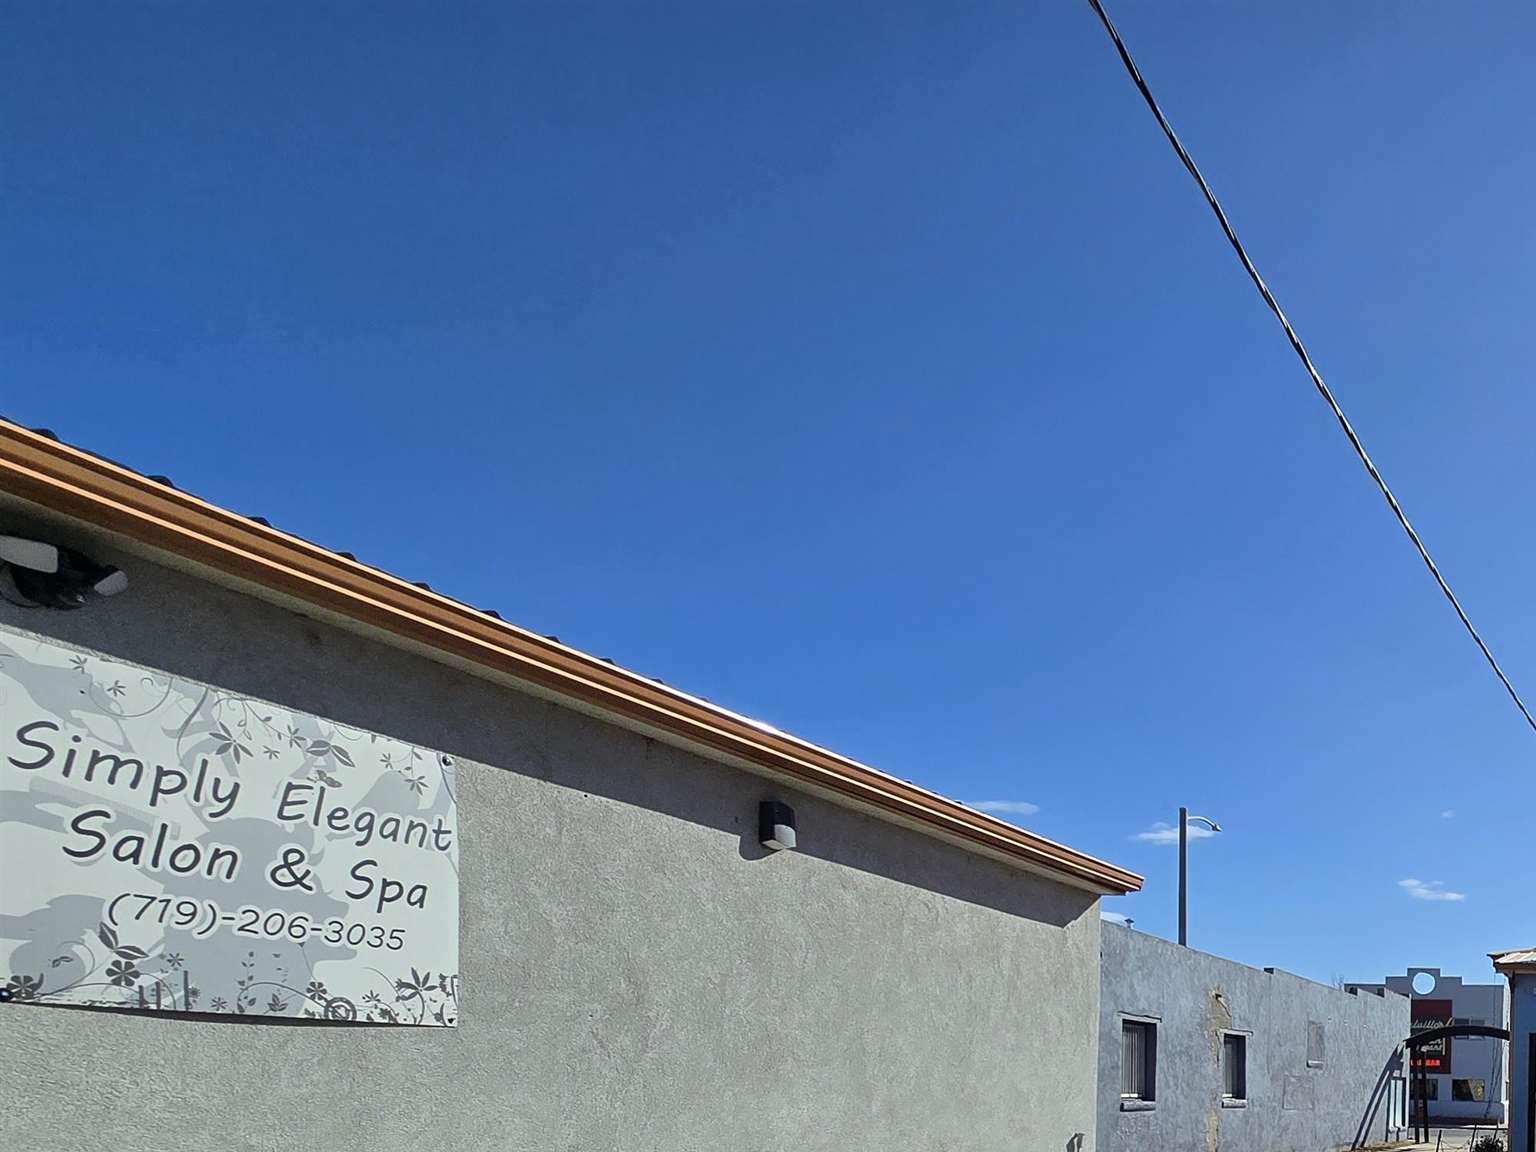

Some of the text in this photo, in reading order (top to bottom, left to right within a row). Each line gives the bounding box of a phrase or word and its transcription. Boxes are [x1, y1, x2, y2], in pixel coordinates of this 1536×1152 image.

[8, 720, 453, 852] Simply Elegant
[62, 809, 429, 914] Salon & Spa
[107, 892, 406, 951] (719)-206-3035
